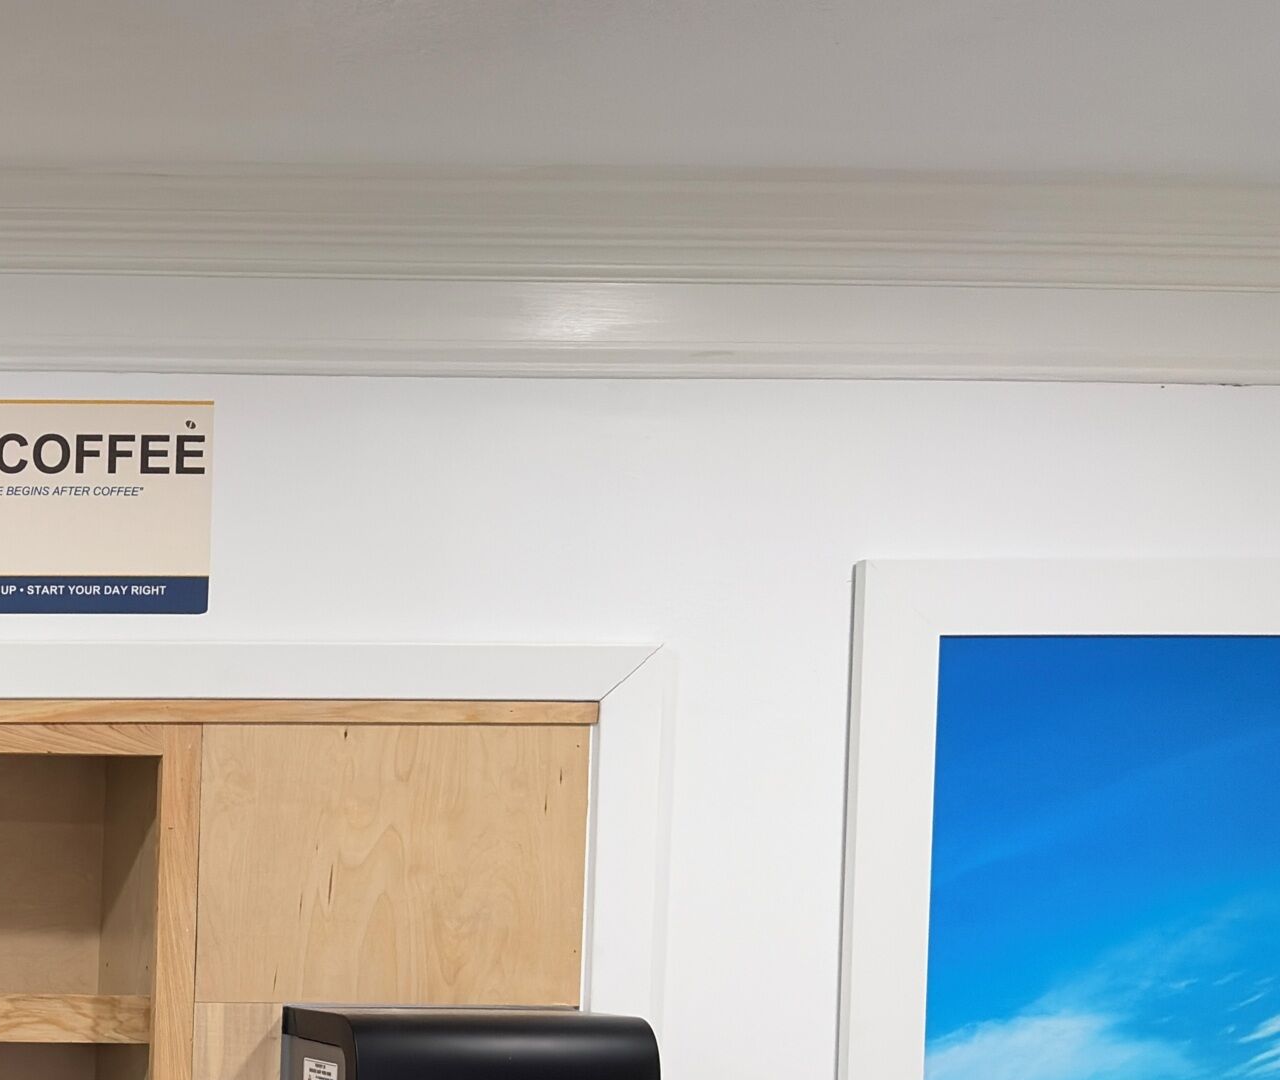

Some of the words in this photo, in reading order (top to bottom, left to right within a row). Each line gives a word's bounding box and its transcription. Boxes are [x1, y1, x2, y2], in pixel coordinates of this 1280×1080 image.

[6, 486, 50, 496] BEGINS
[52, 486, 90, 496] AFTER
[93, 486, 144, 497] COFFEE"
[27, 585, 66, 596] START
[68, 585, 101, 596] YOUR
[103, 585, 128, 596] DAY
[131, 585, 167, 596] RIGHT
